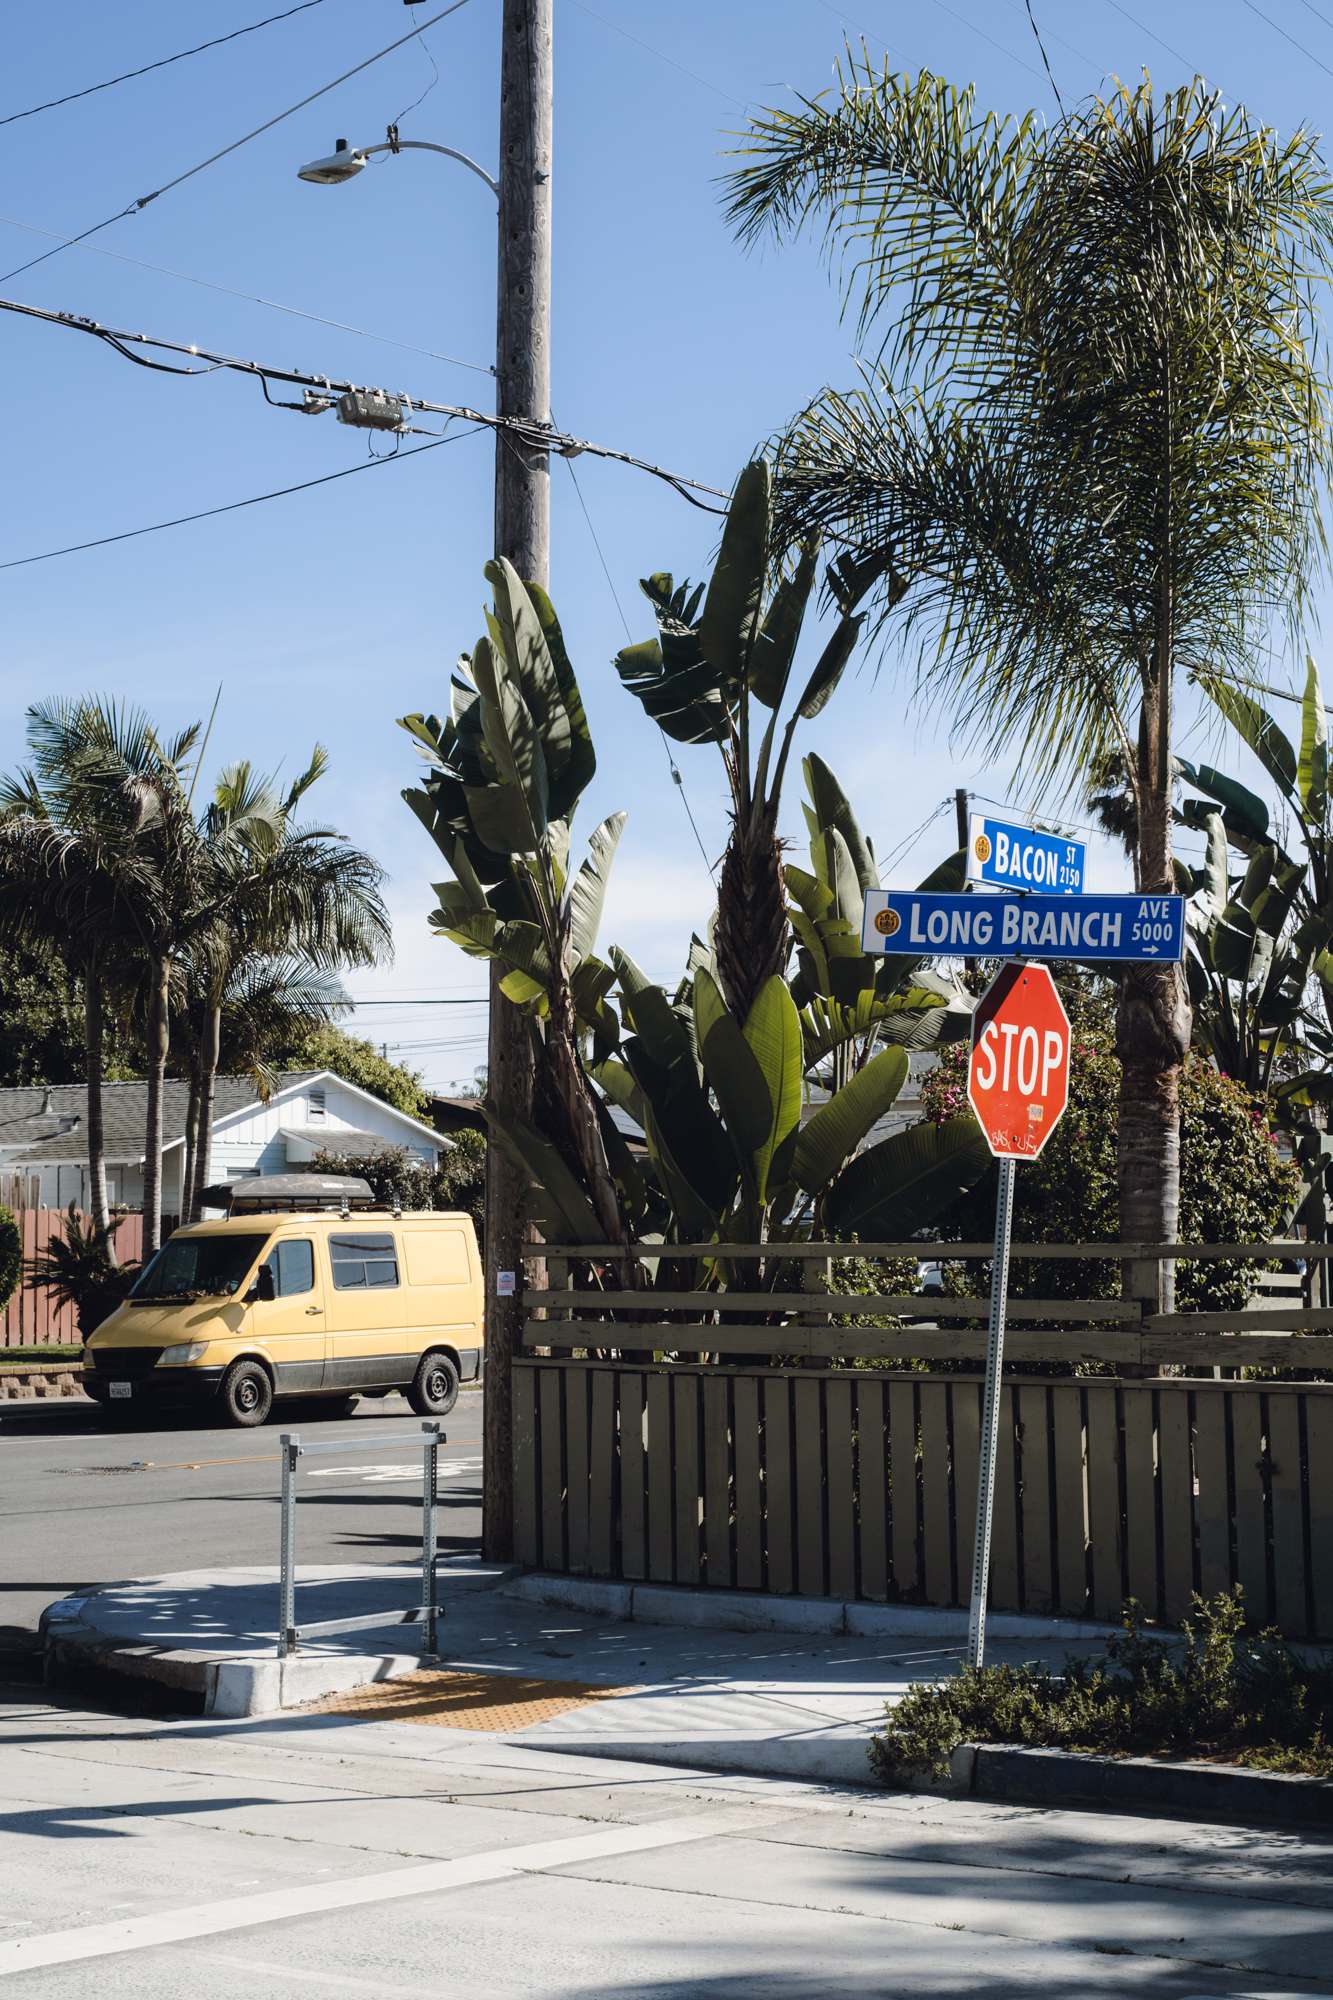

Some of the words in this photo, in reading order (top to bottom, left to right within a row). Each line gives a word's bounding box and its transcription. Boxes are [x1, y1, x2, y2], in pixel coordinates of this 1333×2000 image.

[995, 832, 1058, 887] BACON
[1066, 846, 1077, 863] ST
[1059, 866, 1080, 887] 2150
[910, 903, 993, 945] LONG
[1002, 905, 1122, 947] BRANCH
[1139, 901, 1170, 919] AVE
[1132, 923, 1173, 941] 5000
[977, 1020, 1063, 1097] STOP
